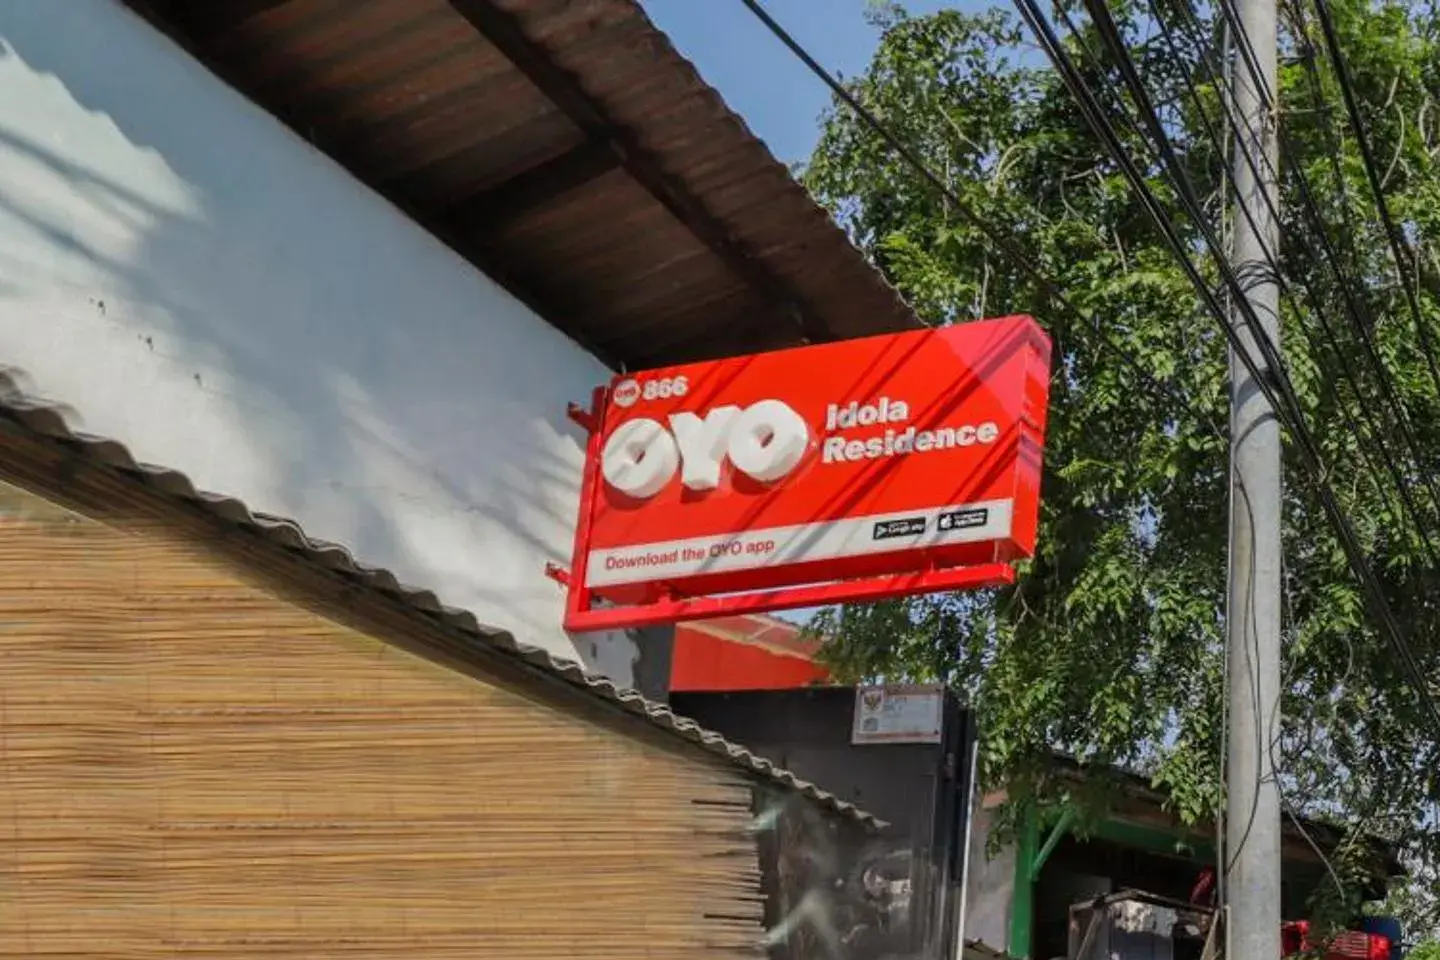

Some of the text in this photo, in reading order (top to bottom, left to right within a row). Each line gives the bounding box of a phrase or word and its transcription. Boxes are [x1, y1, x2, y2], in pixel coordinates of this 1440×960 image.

[643, 375, 689, 400] 866
[825, 396, 909, 430] Idola
[602, 399, 810, 498] OYO
[822, 421, 999, 463] Residence
[605, 539, 775, 570] Download the OYO app
